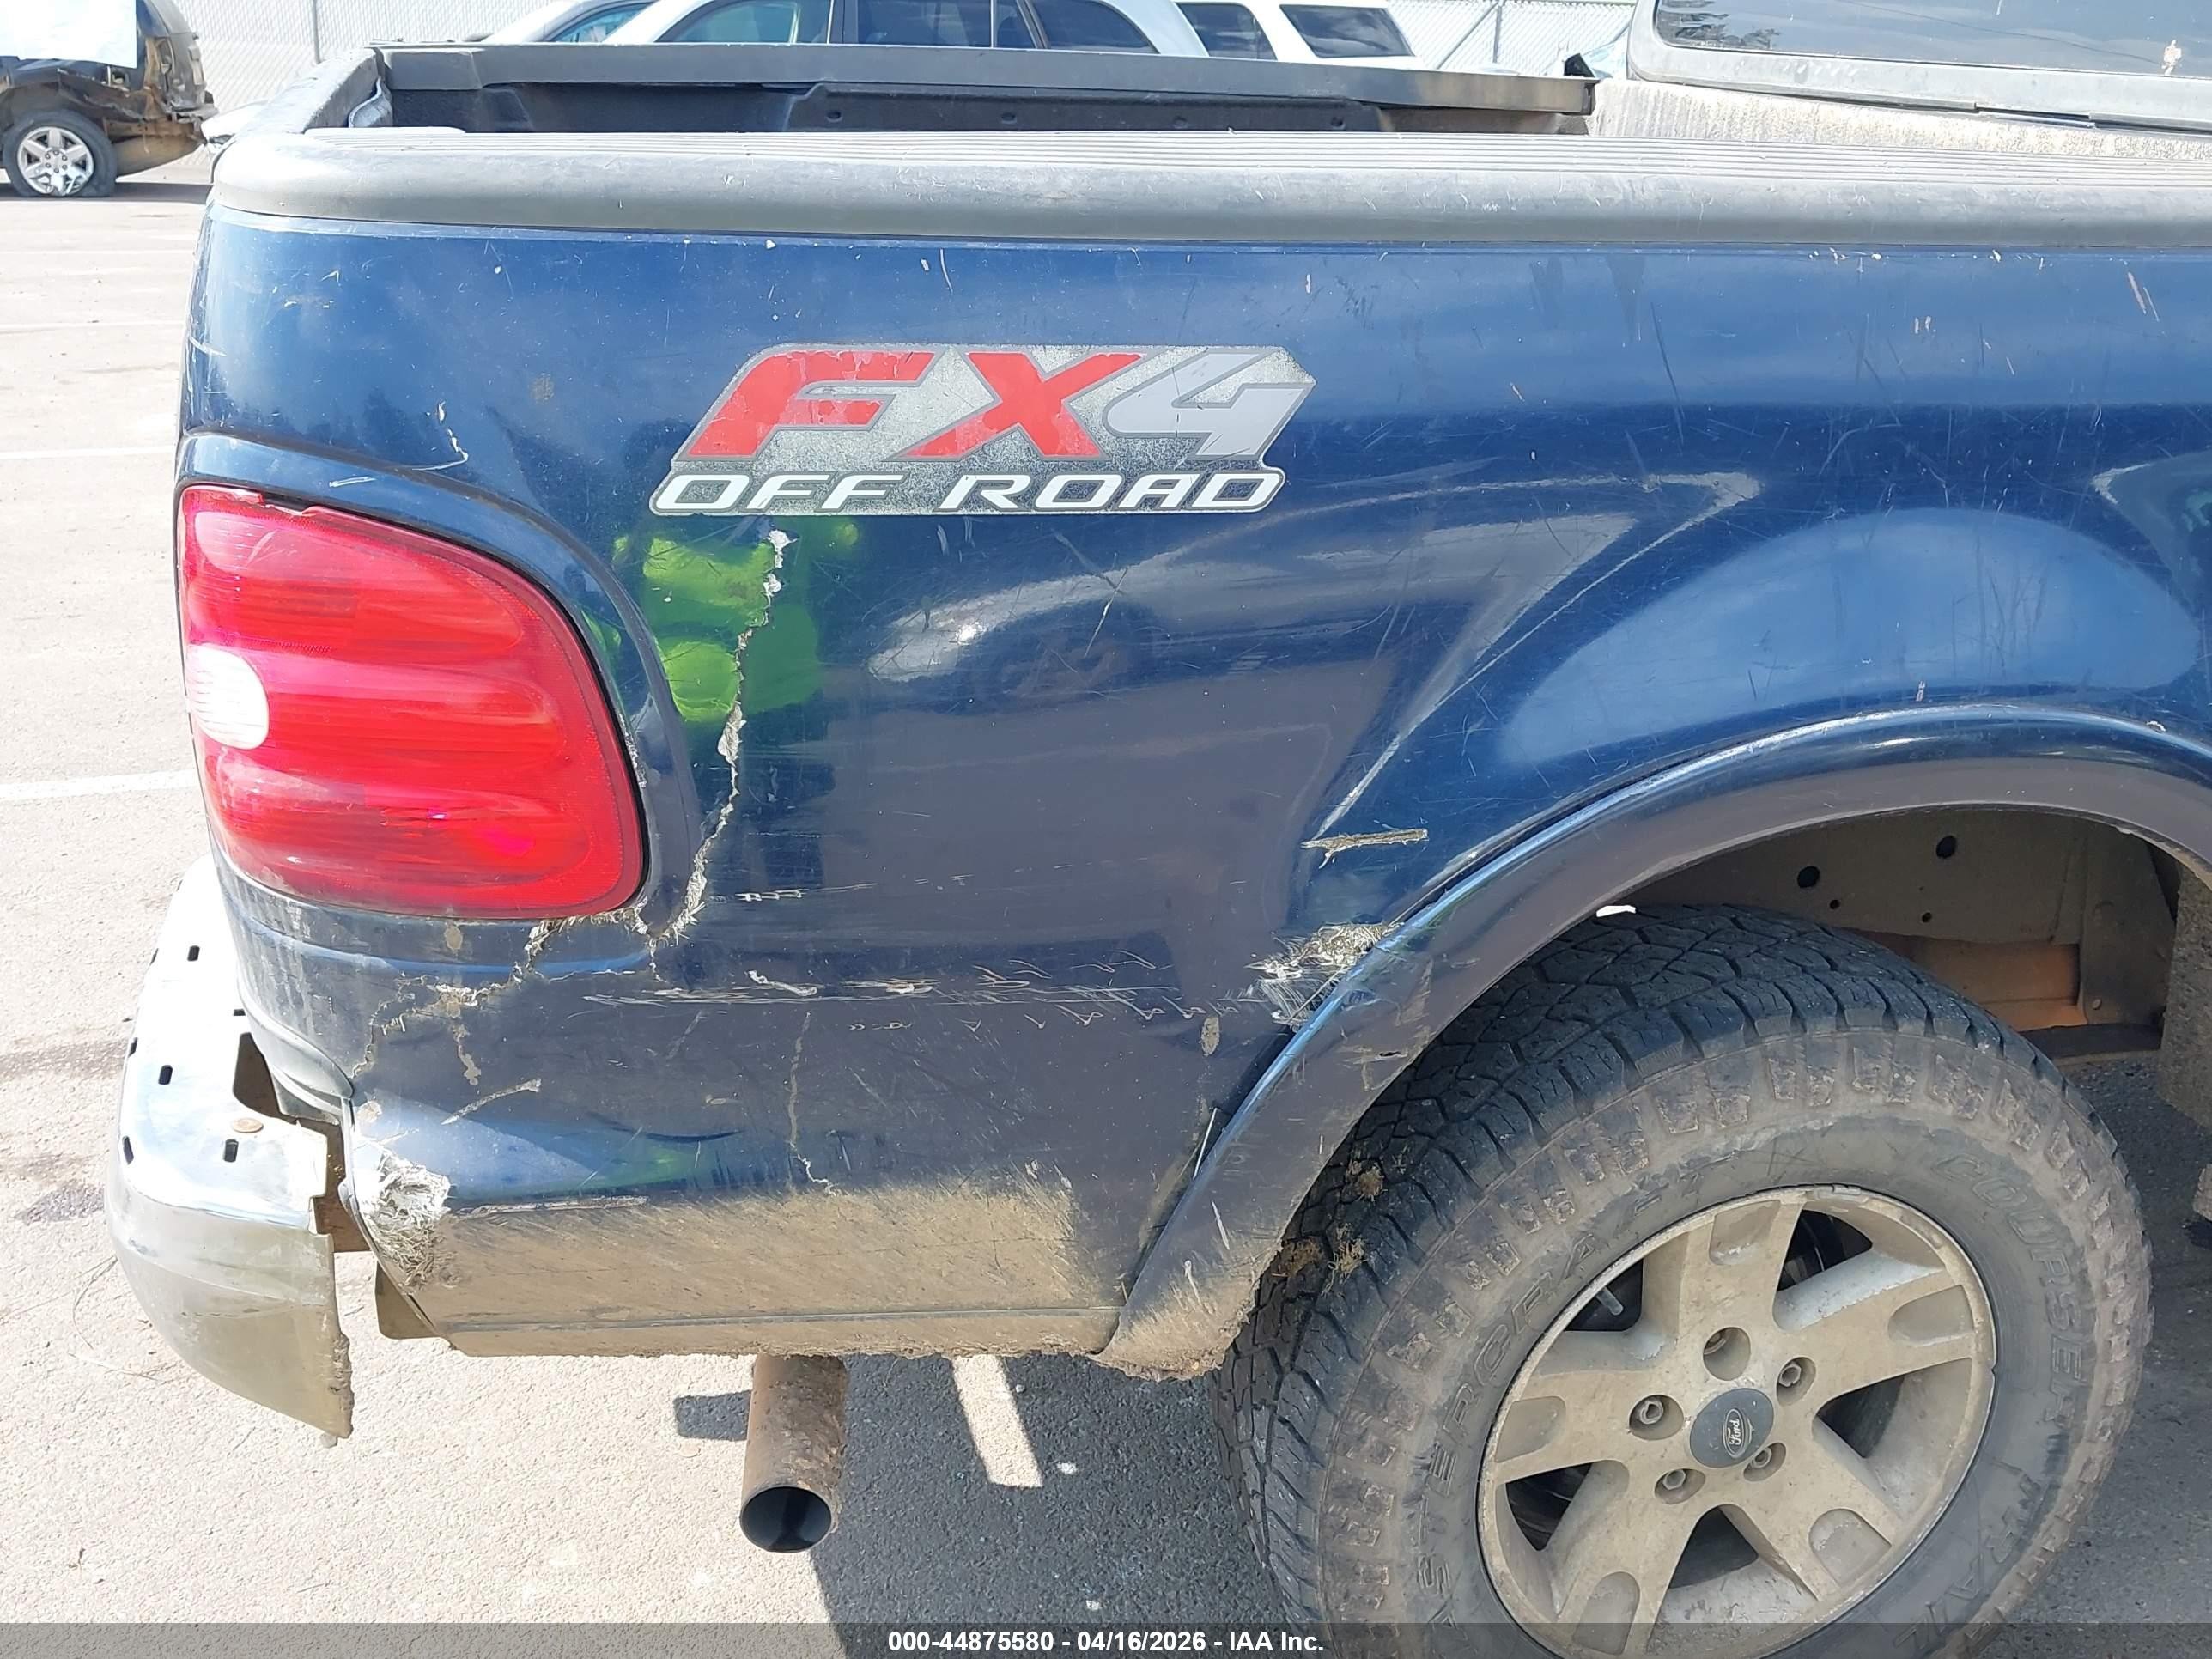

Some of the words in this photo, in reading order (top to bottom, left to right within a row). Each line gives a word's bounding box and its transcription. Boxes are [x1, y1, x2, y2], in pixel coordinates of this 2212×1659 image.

[682, 348, 1312, 460] FX4
[654, 473, 904, 510] OFF
[938, 472, 1282, 510] ROAD
[1727, 1418, 1742, 1446] Ford
